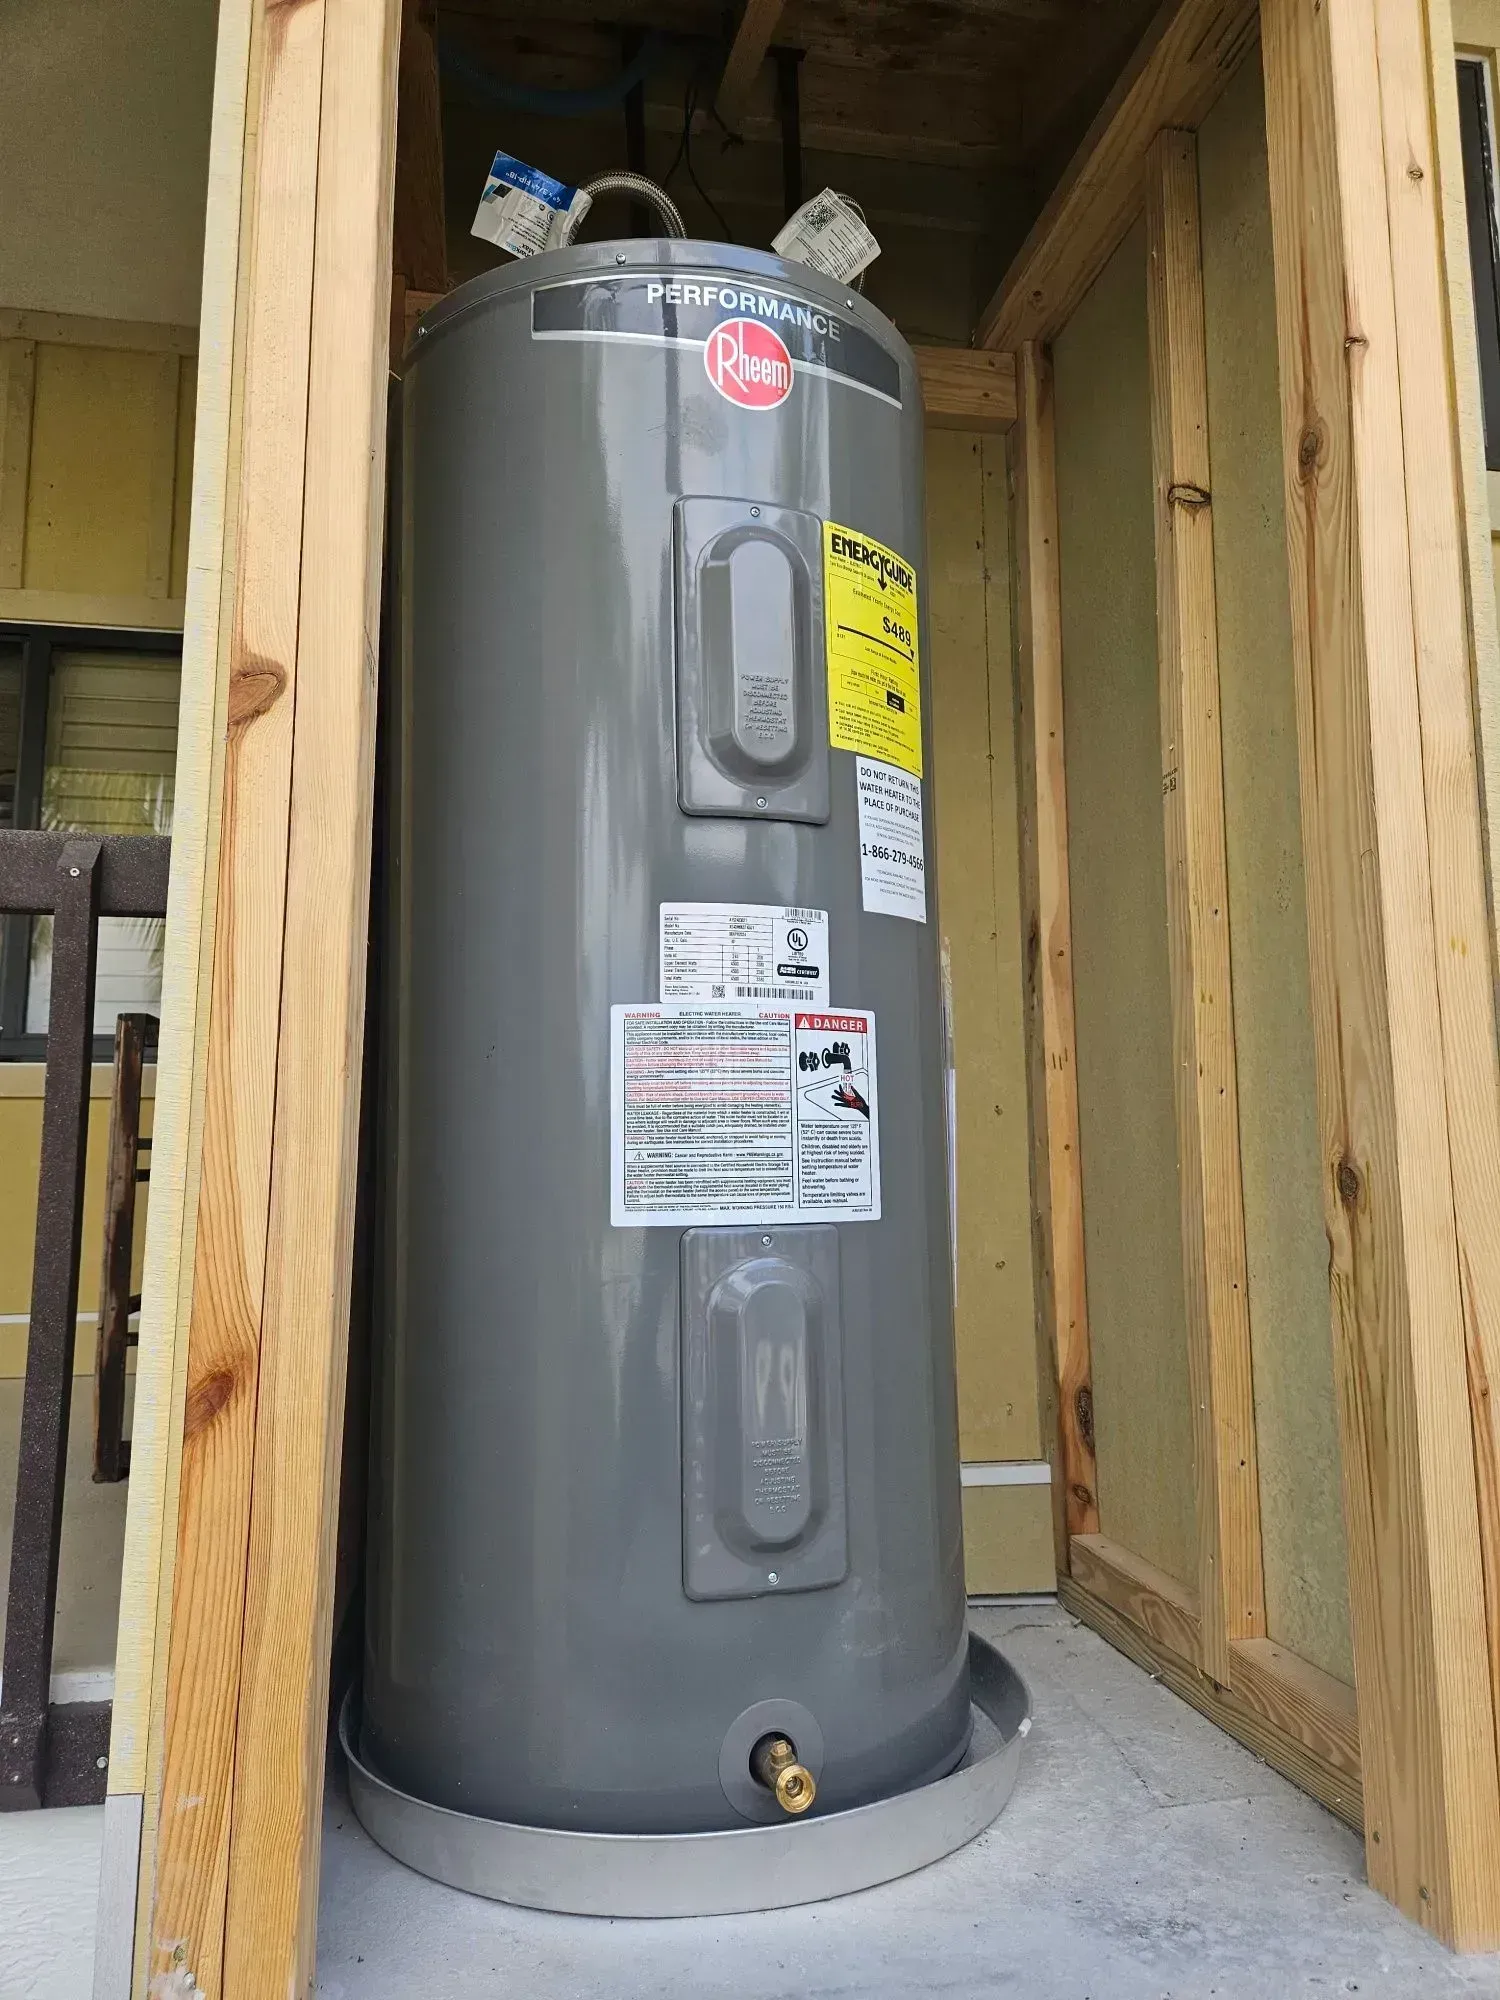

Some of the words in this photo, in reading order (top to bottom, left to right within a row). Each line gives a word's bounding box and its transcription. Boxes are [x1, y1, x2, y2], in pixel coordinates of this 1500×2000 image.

[648, 284, 840, 342] PERFORMANCE
[717, 322, 787, 392] Rheem
[832, 533, 913, 594] ENERGYGUIDE
[883, 616, 910, 647] $489
[861, 767, 871, 777] DO
[874, 770, 886, 780] NOT
[888, 774, 909, 790] RETURN
[860, 781, 883, 795] WATER
[885, 788, 905, 802] HEATER
[906, 795, 912, 805] TO
[864, 797, 884, 810] PLACE
[886, 802, 893, 812] OF
[862, 843, 923, 871] 1-866-279-4566
[793, 933, 803, 946] UL
[814, 1018, 863, 1031] DANGER
